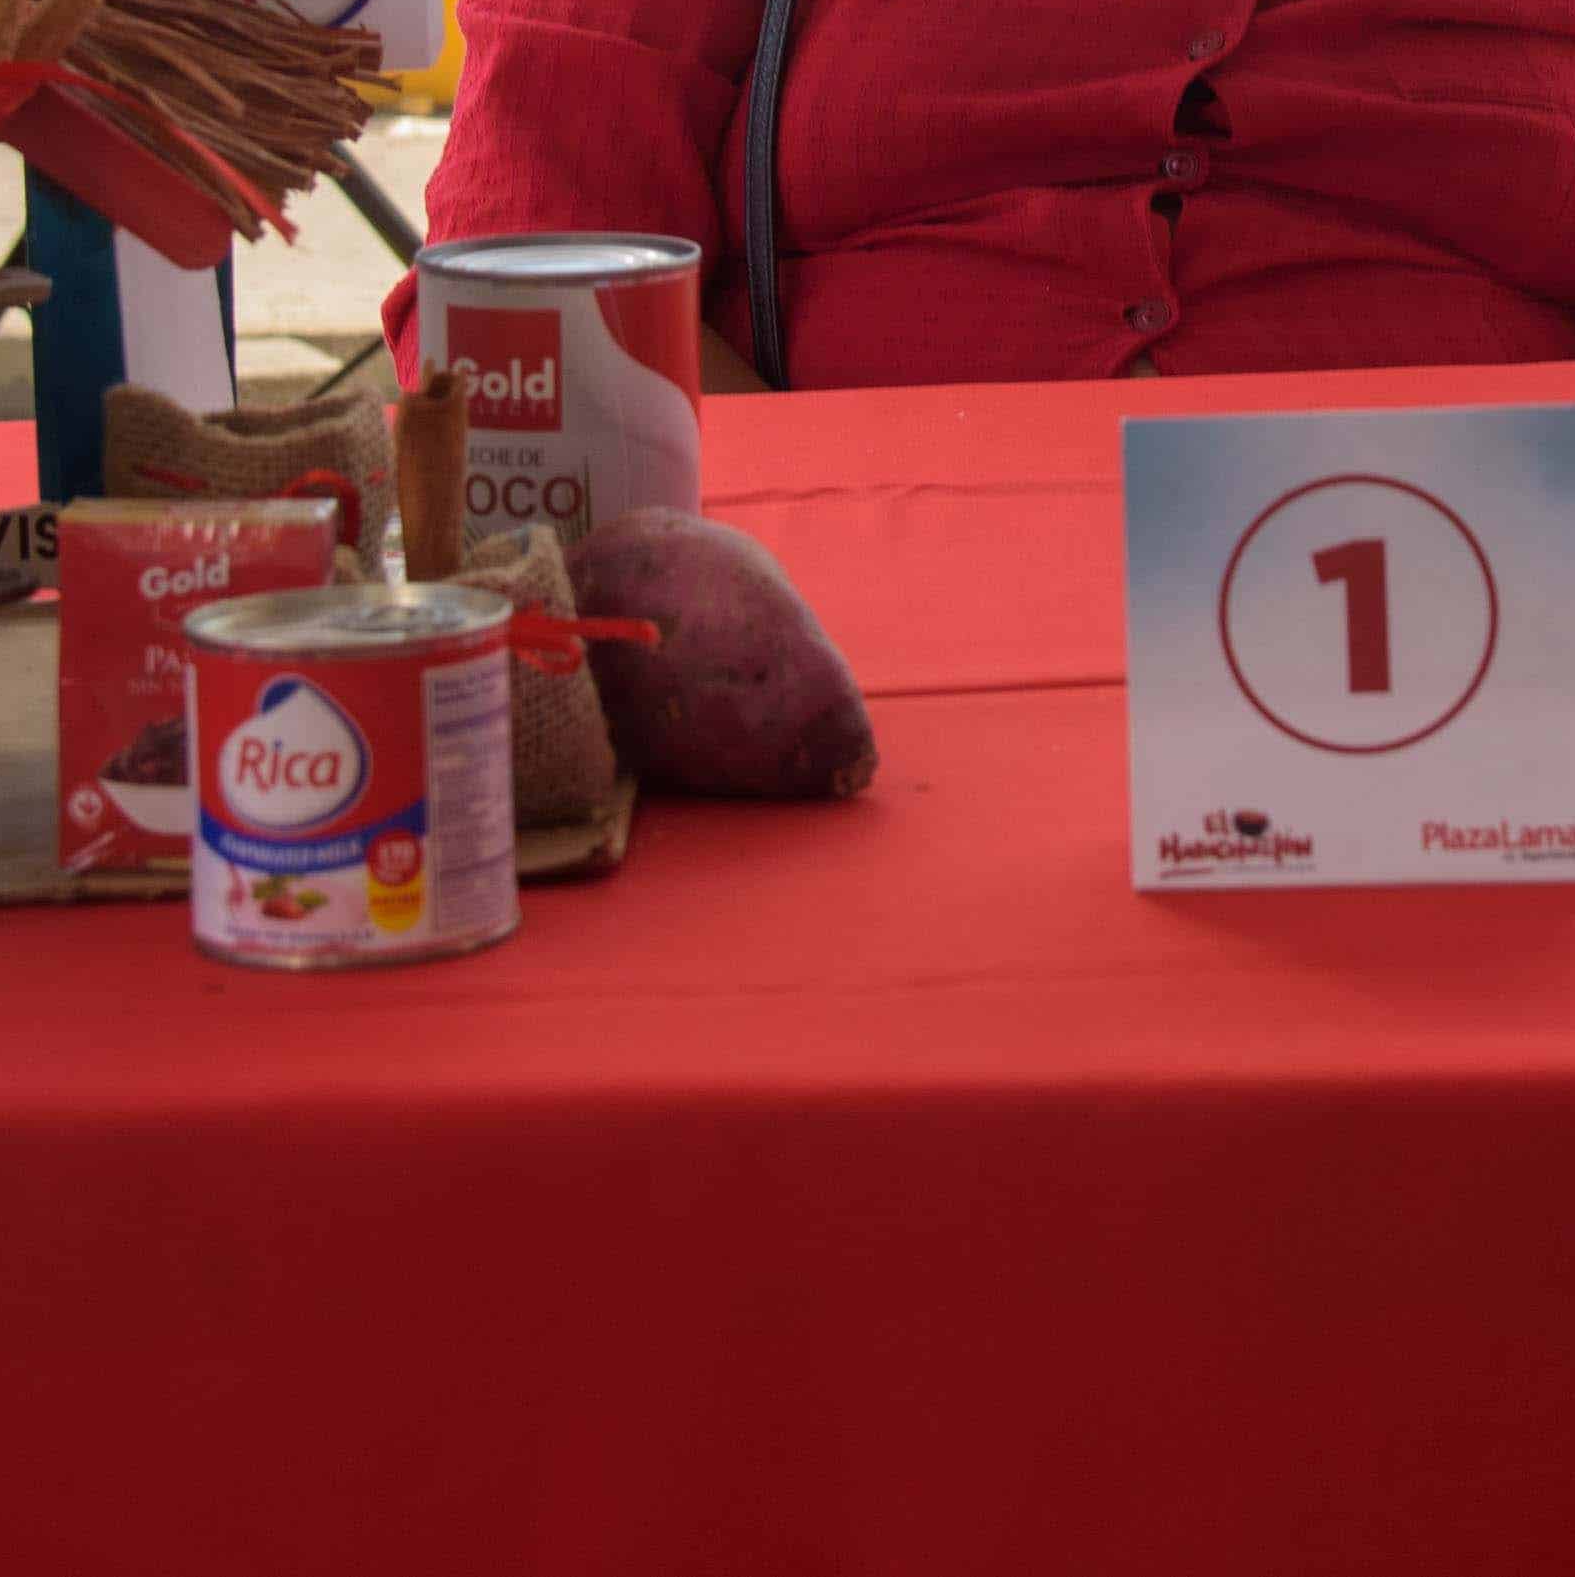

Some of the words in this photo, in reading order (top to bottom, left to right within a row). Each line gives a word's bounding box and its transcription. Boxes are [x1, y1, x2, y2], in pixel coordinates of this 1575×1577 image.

[452, 356, 556, 401] Gold
[465, 473, 584, 521] OCO
[139, 552, 230, 601] Gold
[1311, 536, 1393, 694] 1
[236, 737, 342, 795] Rica
